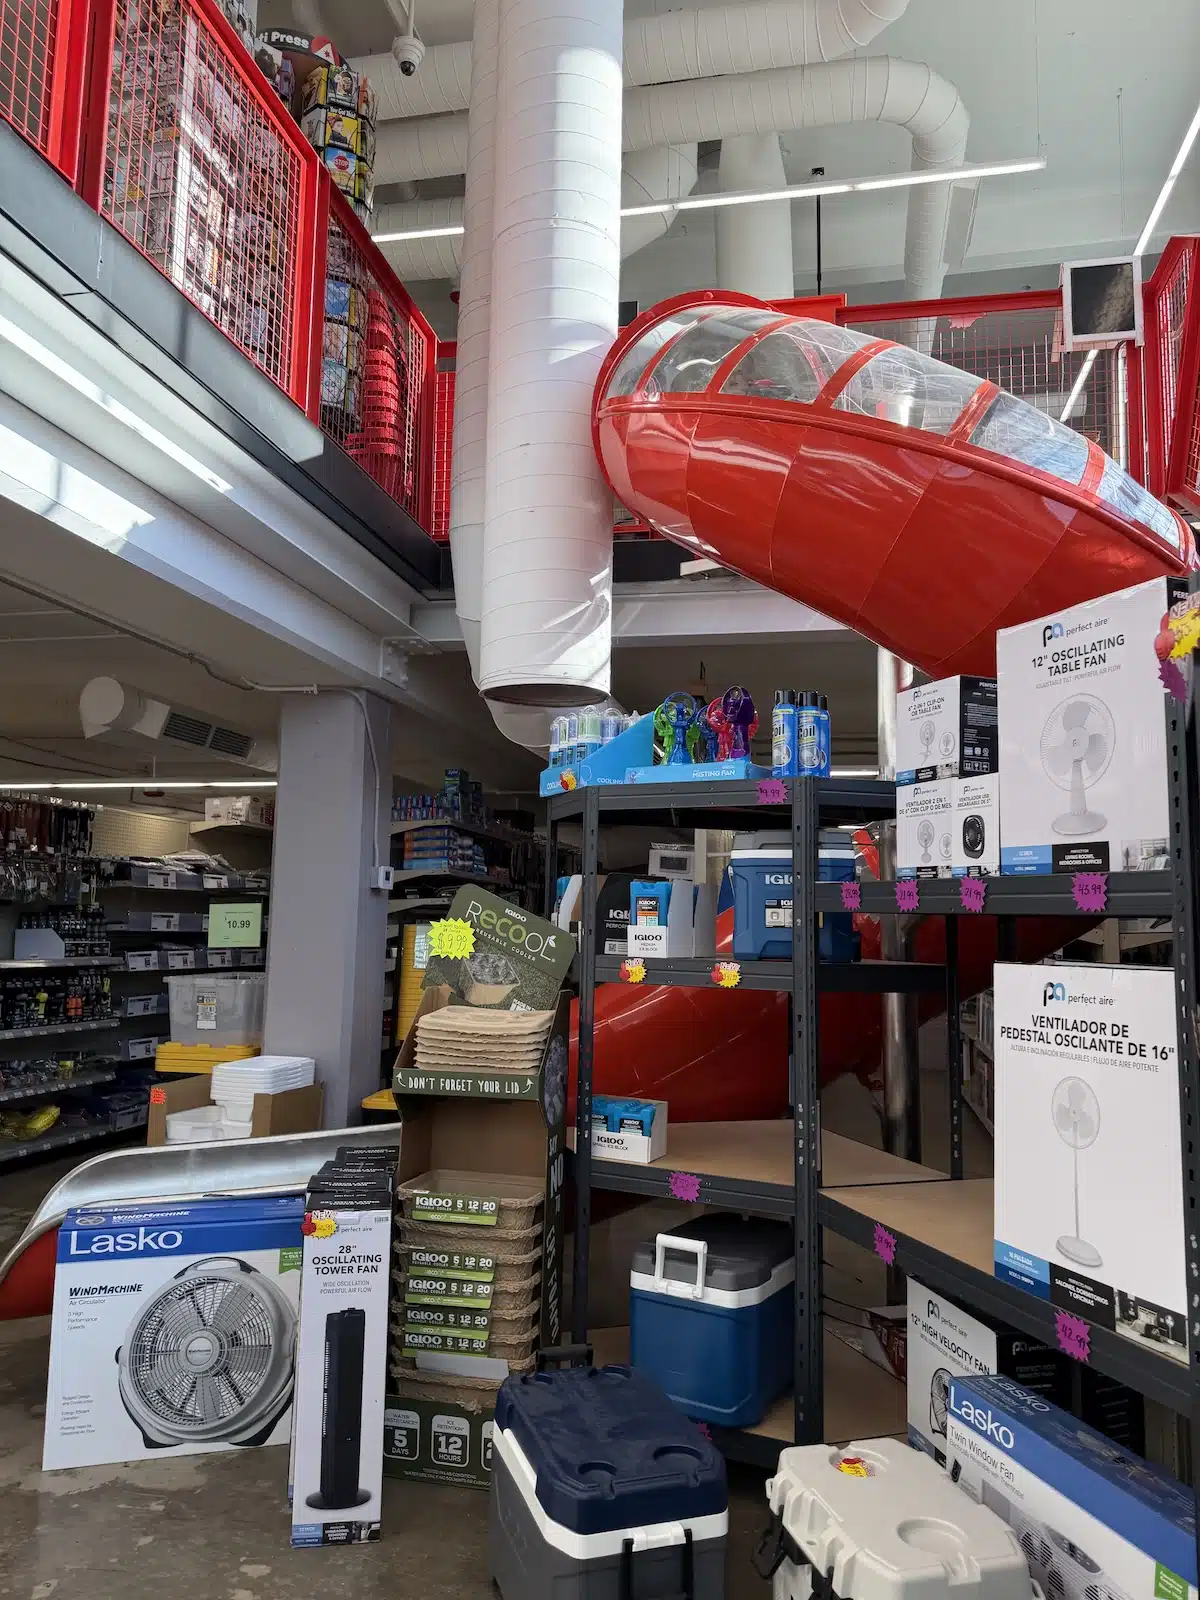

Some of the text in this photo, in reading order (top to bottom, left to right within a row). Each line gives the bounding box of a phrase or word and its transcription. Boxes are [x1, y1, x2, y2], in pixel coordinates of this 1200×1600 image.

[271, 31, 310, 49] Press
[1066, 618, 1108, 638] perfect aire
[1032, 634, 1125, 669] 12" OSCILLATING
[1048, 653, 1107, 676] TABLE FAN
[692, 768, 735, 778] MISTING FAN
[505, 908, 526, 922] IGLOO
[227, 919, 251, 929] 10.99
[634, 933, 662, 942] IGLOO
[511, 946, 537, 962] COOLER
[1068, 993, 1114, 1006] perfect aire
[1032, 1014, 1129, 1039] VENTILADOR DE
[1000, 1026, 1175, 1061] PEDESTAL OSCILANTE DE 16"
[408, 1076, 520, 1094] DON'T FORGET YOUR LID
[597, 1135, 625, 1146] IGLOO
[415, 1196, 496, 1211] IGLOO 5 12 20
[341, 1224, 372, 1234] perfect aire
[70, 1227, 183, 1255] Lasko
[338, 1245, 357, 1254] 28"
[312, 1254, 382, 1266] OSCILLATING
[411, 1251, 493, 1268] IGLOO 5 12 20
[314, 1264, 379, 1276] TOWER FAN
[337, 1280, 370, 1288] OSCILLATION
[408, 1279, 491, 1295] IGLOO 5 12 20
[406, 1309, 443, 1321] IGLOO
[448, 1313, 456, 1322] 5
[459, 1314, 471, 1324] 12
[474, 1315, 488, 1326] 20
[404, 1333, 442, 1345] IGLOO
[446, 1337, 454, 1347] 5
[457, 1338, 469, 1348] 12
[472, 1339, 486, 1349] 20
[921, 1320, 938, 1341] HIGH
[939, 1332, 973, 1365] VELOCITY
[974, 1357, 990, 1376] FAN
[949, 1386, 1015, 1450] Lasko
[393, 1428, 408, 1448] 5
[437, 1435, 463, 1456] 12
[391, 1446, 410, 1456] DAYS
[438, 1452, 462, 1463] HOURS
[949, 1425, 1015, 1482] Twin Window Fan
